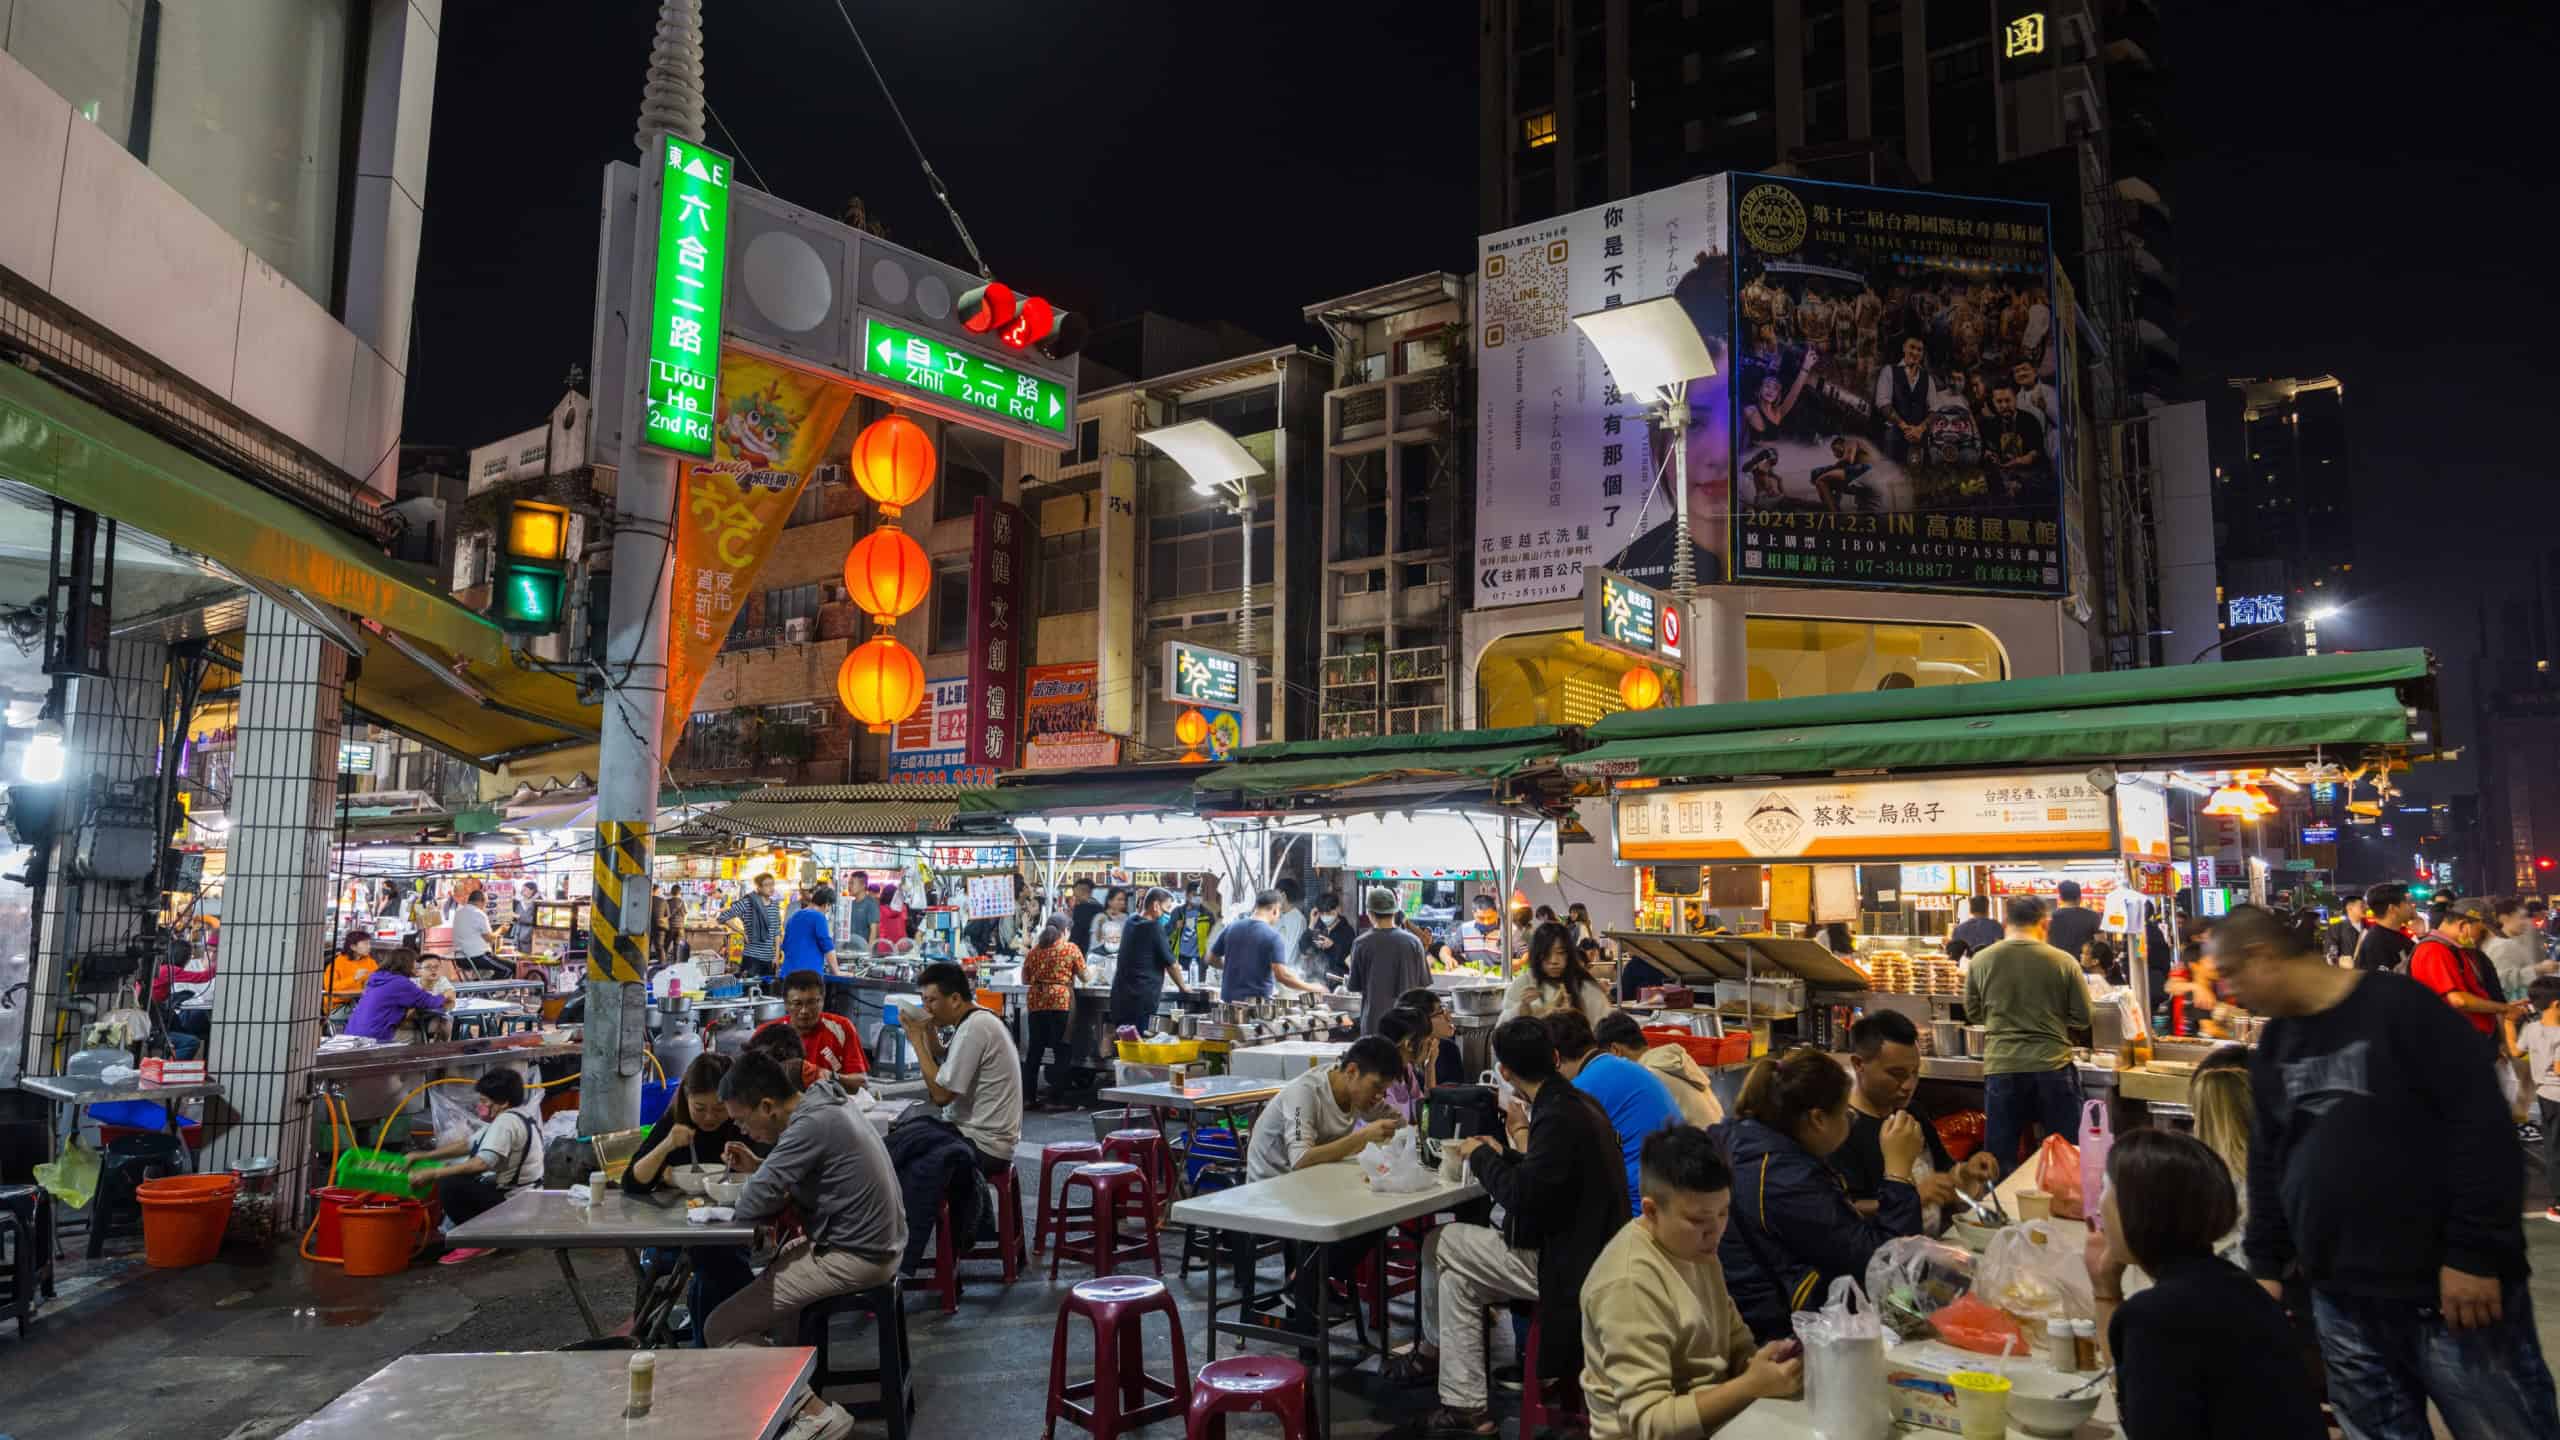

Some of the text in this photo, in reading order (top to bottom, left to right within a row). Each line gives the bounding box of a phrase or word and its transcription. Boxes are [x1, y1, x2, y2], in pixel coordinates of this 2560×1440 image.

[668, 145, 683, 169] 東
[669, 193, 711, 356] 六合二路
[1512, 287, 1540, 303] LINE
[660, 363, 706, 392] Liou
[905, 338, 1040, 400] 自立二路
[667, 388, 698, 414] He
[905, 364, 1041, 424] Zihli 2nd Rd.
[649, 410, 712, 441] 2nd Rd.
[1746, 510, 1917, 535] 2024 3/1.2.3 IN
[1926, 513, 2058, 546] 高雄展覽館
[1502, 561, 1583, 583] 往前兩百公尺
[696, 568, 713, 641] 賀新年
[714, 572, 734, 612] 夜市
[2228, 594, 2286, 628] 商旅
[1813, 803, 1856, 828] 蔡家
[1878, 801, 1945, 826] 烏魚子
